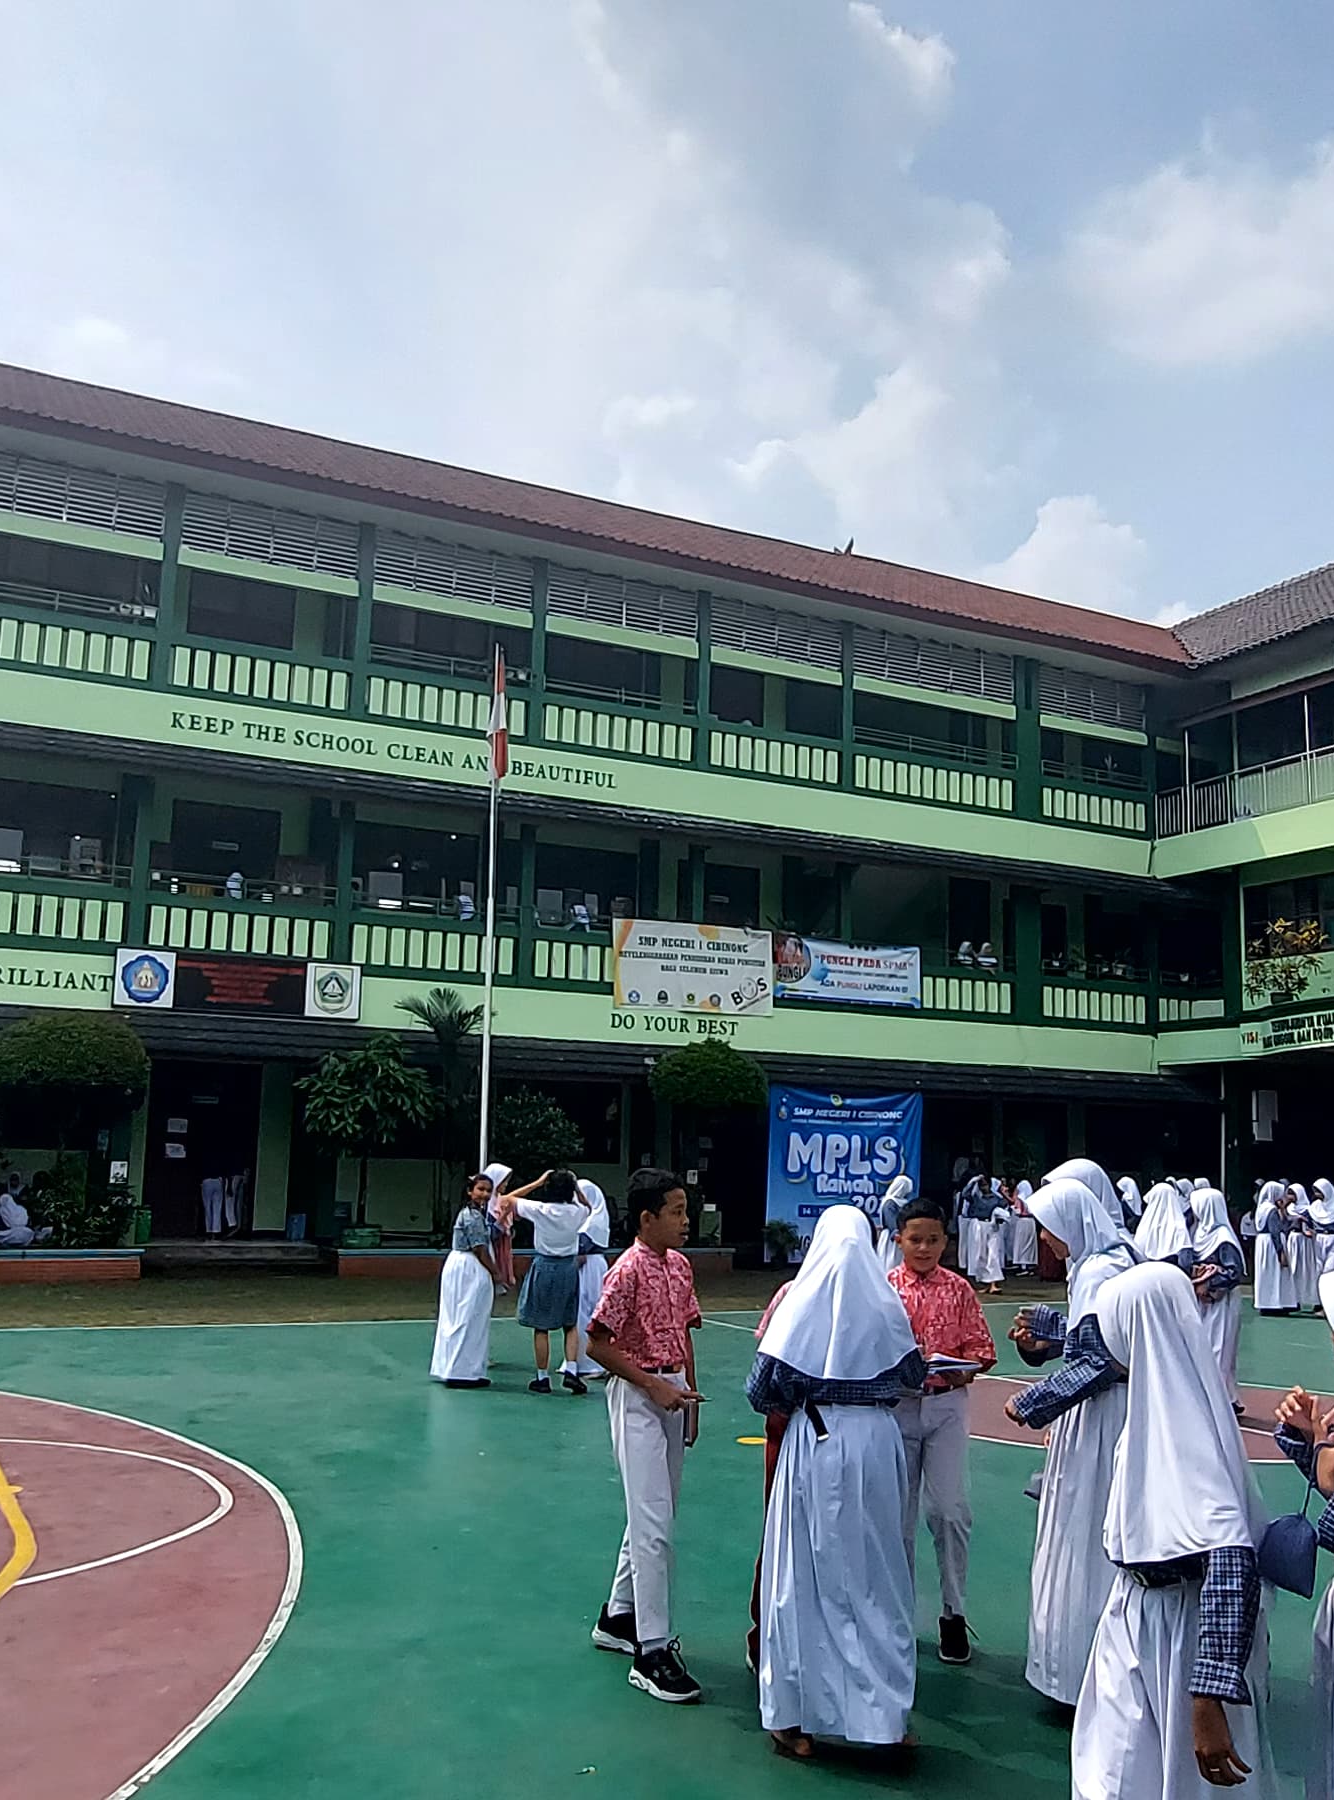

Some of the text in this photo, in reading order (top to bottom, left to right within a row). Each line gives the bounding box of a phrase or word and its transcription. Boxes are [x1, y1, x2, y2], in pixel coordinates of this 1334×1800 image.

[170, 711, 617, 789] KEEP THE SCHOOL CLEAN AN BEAUTIFUL
[637, 935, 658, 947] SMP
[661, 937, 695, 949] NEGERI
[611, 1013, 739, 1036] DO YOUR BEST
[793, 1107, 813, 1116] SMP
[787, 1132, 898, 1175] MPLS
[816, 1174, 874, 1194] Ramah
